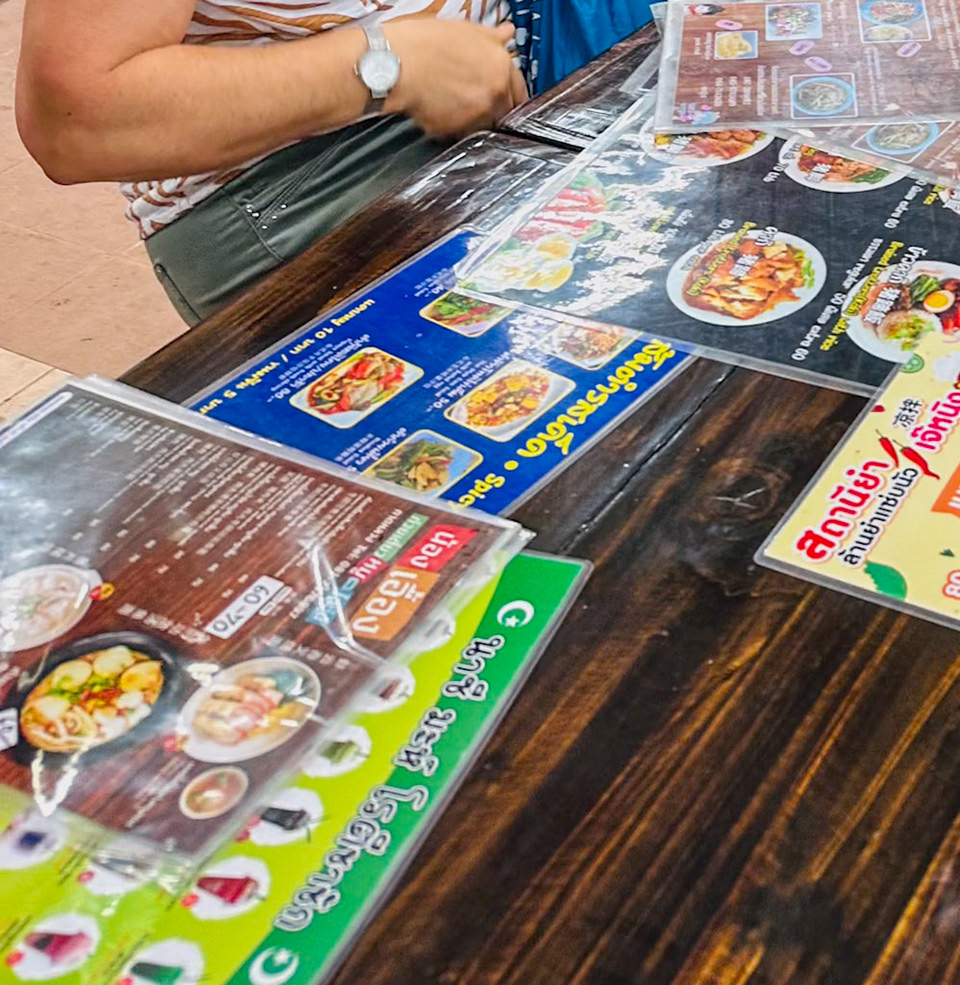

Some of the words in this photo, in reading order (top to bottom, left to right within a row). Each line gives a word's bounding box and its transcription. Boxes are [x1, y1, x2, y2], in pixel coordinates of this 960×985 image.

[793, 459, 890, 561] สถานียำ
[407, 530, 459, 569] น้อง
[349, 568, 427, 635] เอื้อง
